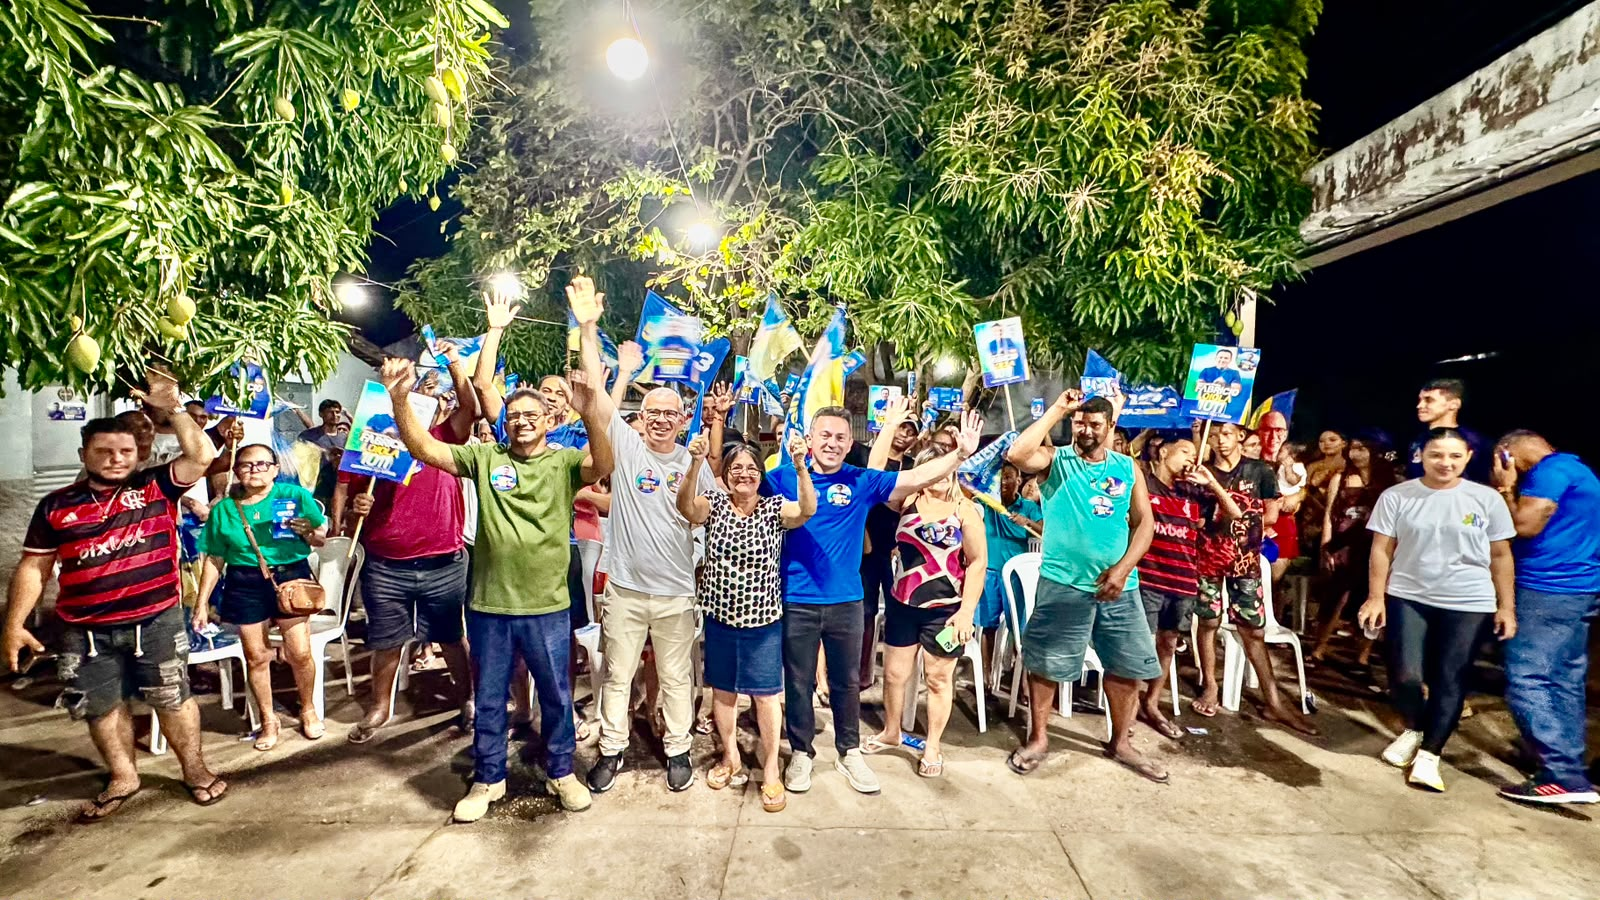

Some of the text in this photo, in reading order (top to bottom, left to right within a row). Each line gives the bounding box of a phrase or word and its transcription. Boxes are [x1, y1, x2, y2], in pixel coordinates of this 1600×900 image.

[1195, 383, 1240, 397] FABRICIO
[1197, 392, 1232, 404] LOIOLA
[1153, 521, 1188, 540] ixbet
